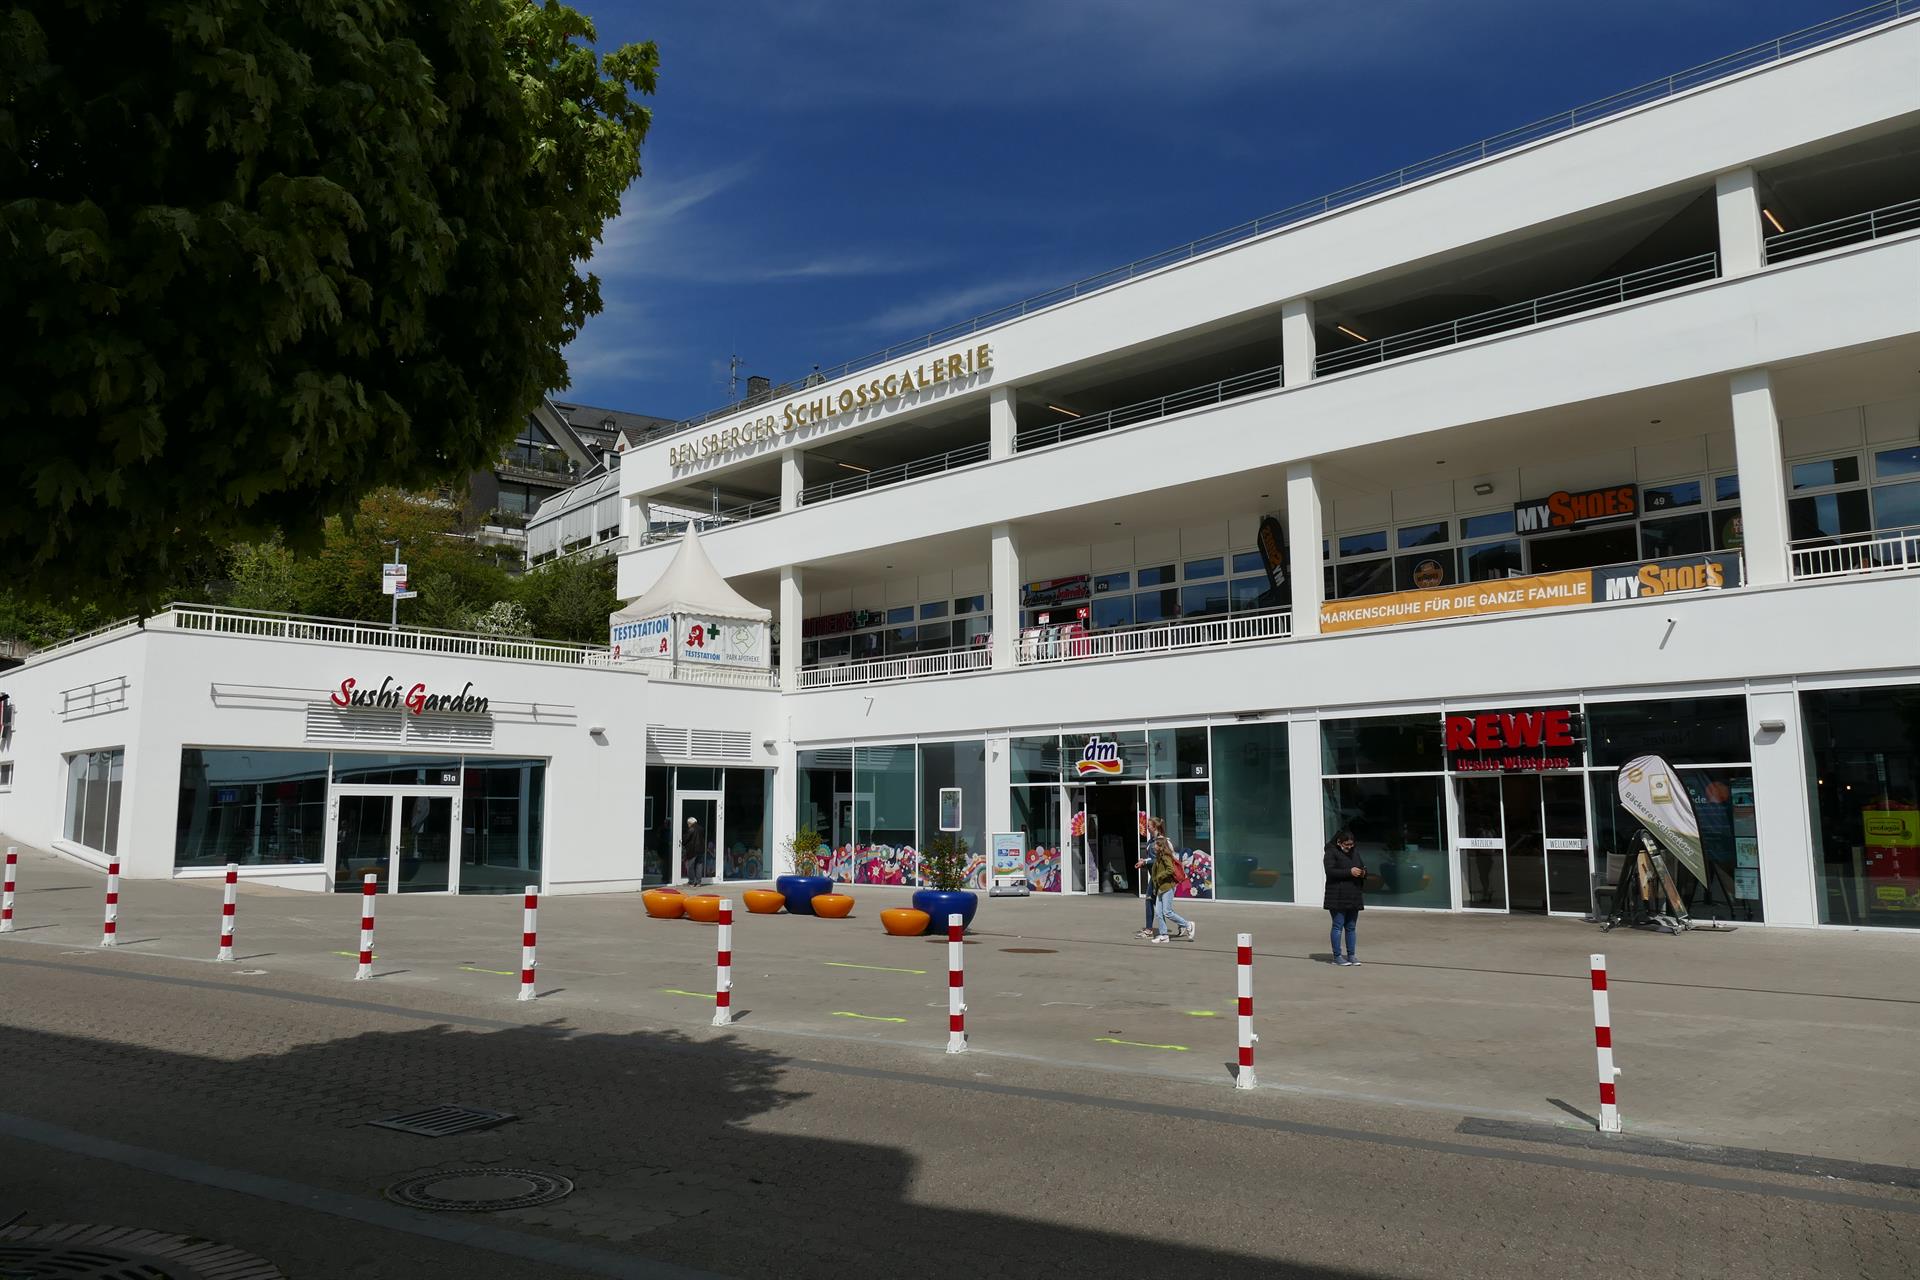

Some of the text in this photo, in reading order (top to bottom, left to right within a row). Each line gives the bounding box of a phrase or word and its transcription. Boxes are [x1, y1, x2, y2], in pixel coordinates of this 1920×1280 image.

[669, 343, 991, 467] BENSBERGER SCHLOSSGALERIE
[1653, 497, 1665, 506] 49
[1320, 582, 1587, 625] MARKENSCHUHE FÜR DIE GANZE FAMILIE
[613, 618, 669, 642] TESTSTATION
[685, 650, 721, 661] TESTSTATION
[330, 675, 489, 715] Sushi Garden
[1445, 709, 1575, 751] REWE
[1084, 738, 1116, 761] dm
[1195, 766, 1203, 775] 51
[1625, 791, 1657, 821] Bäckerei
